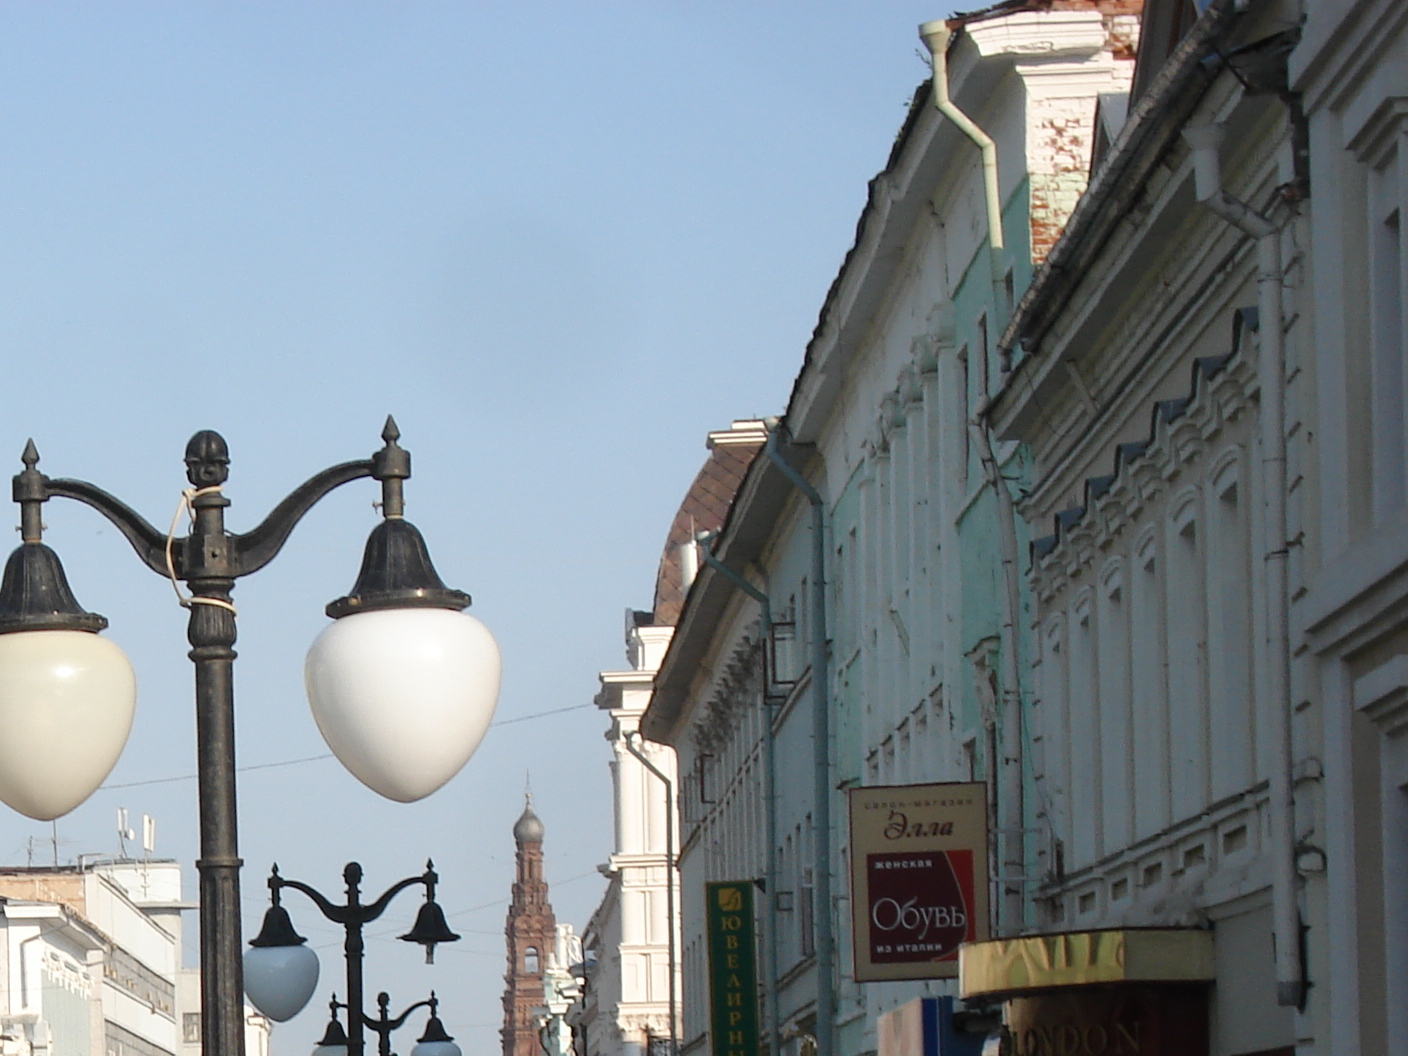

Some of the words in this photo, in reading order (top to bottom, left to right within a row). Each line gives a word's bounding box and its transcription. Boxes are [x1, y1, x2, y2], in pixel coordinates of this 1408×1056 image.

[884, 810, 955, 840] Элла
[874, 859, 933, 870] женская
[872, 896, 966, 940] Обувь
[876, 944, 893, 954] из
[896, 943, 943, 954] италии
